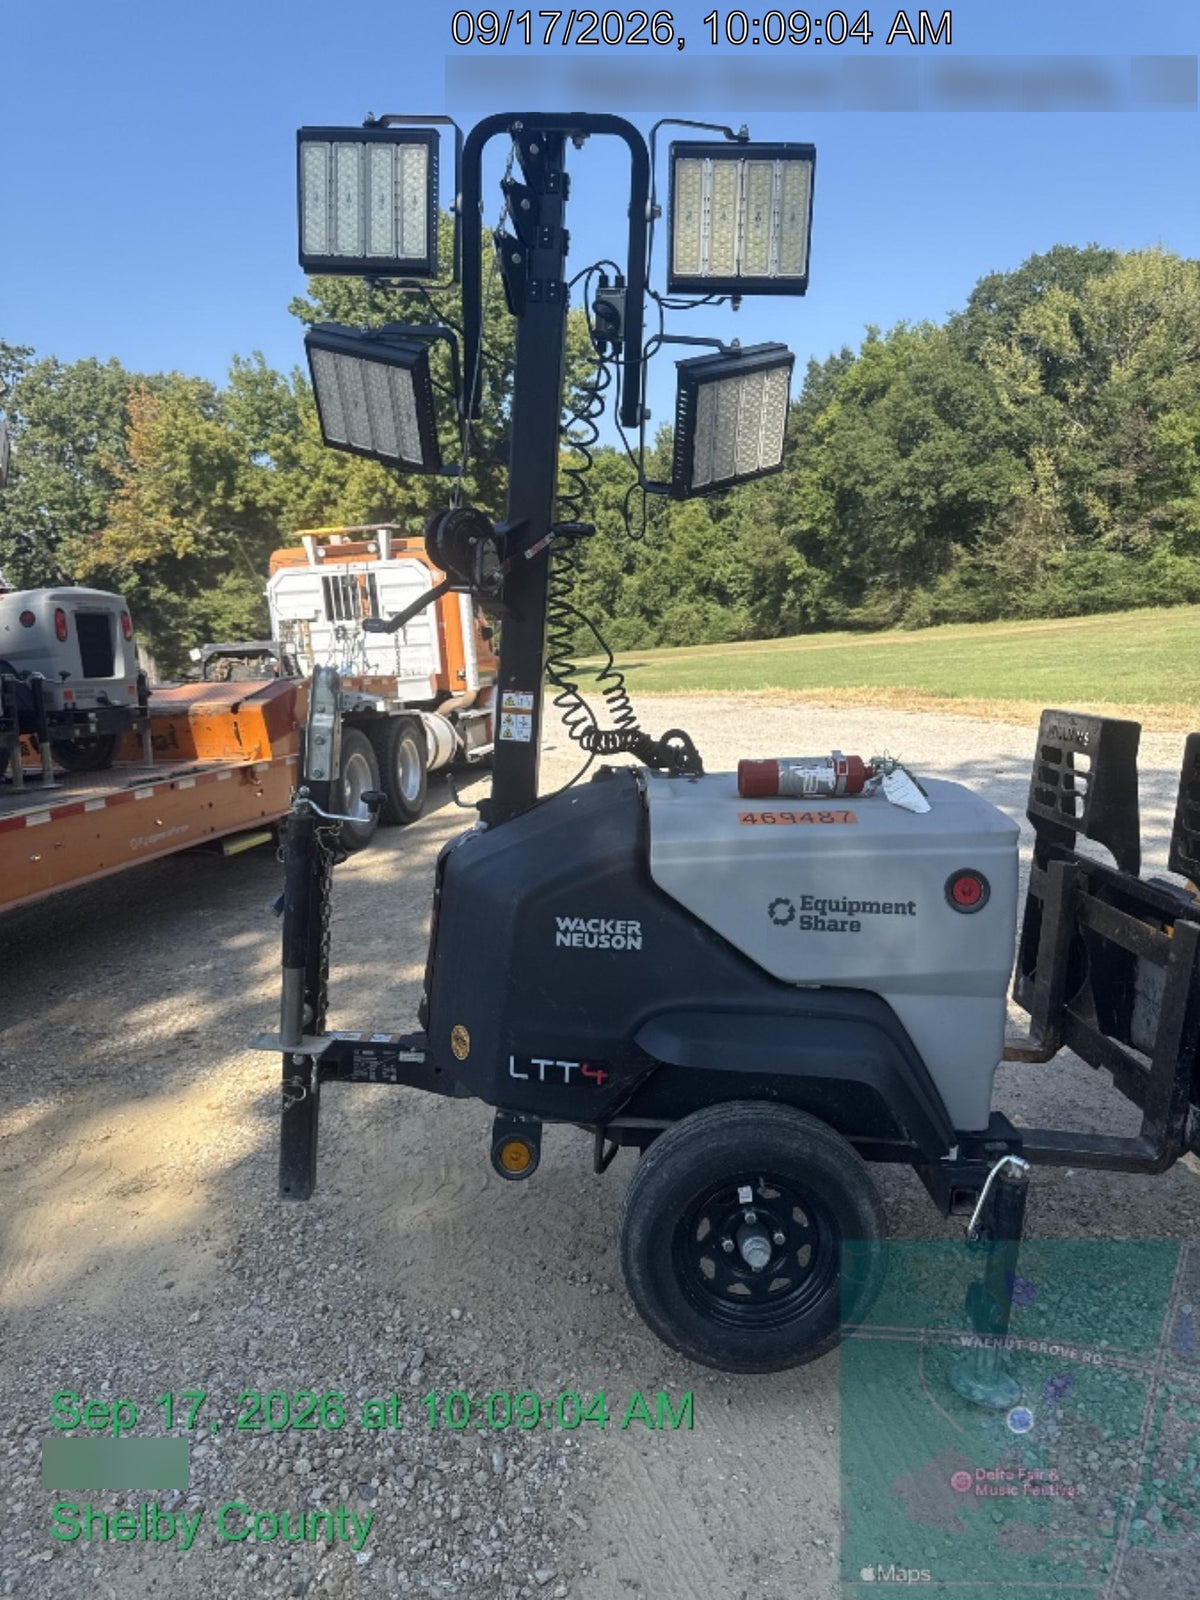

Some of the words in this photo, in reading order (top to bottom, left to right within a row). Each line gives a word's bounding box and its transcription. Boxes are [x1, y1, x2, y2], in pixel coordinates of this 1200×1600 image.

[800, 895, 917, 917] Equipment
[555, 916, 642, 936] WACKER
[800, 915, 861, 932] Share
[555, 932, 643, 950] NEUSON
[509, 1055, 608, 1085] LTT4
